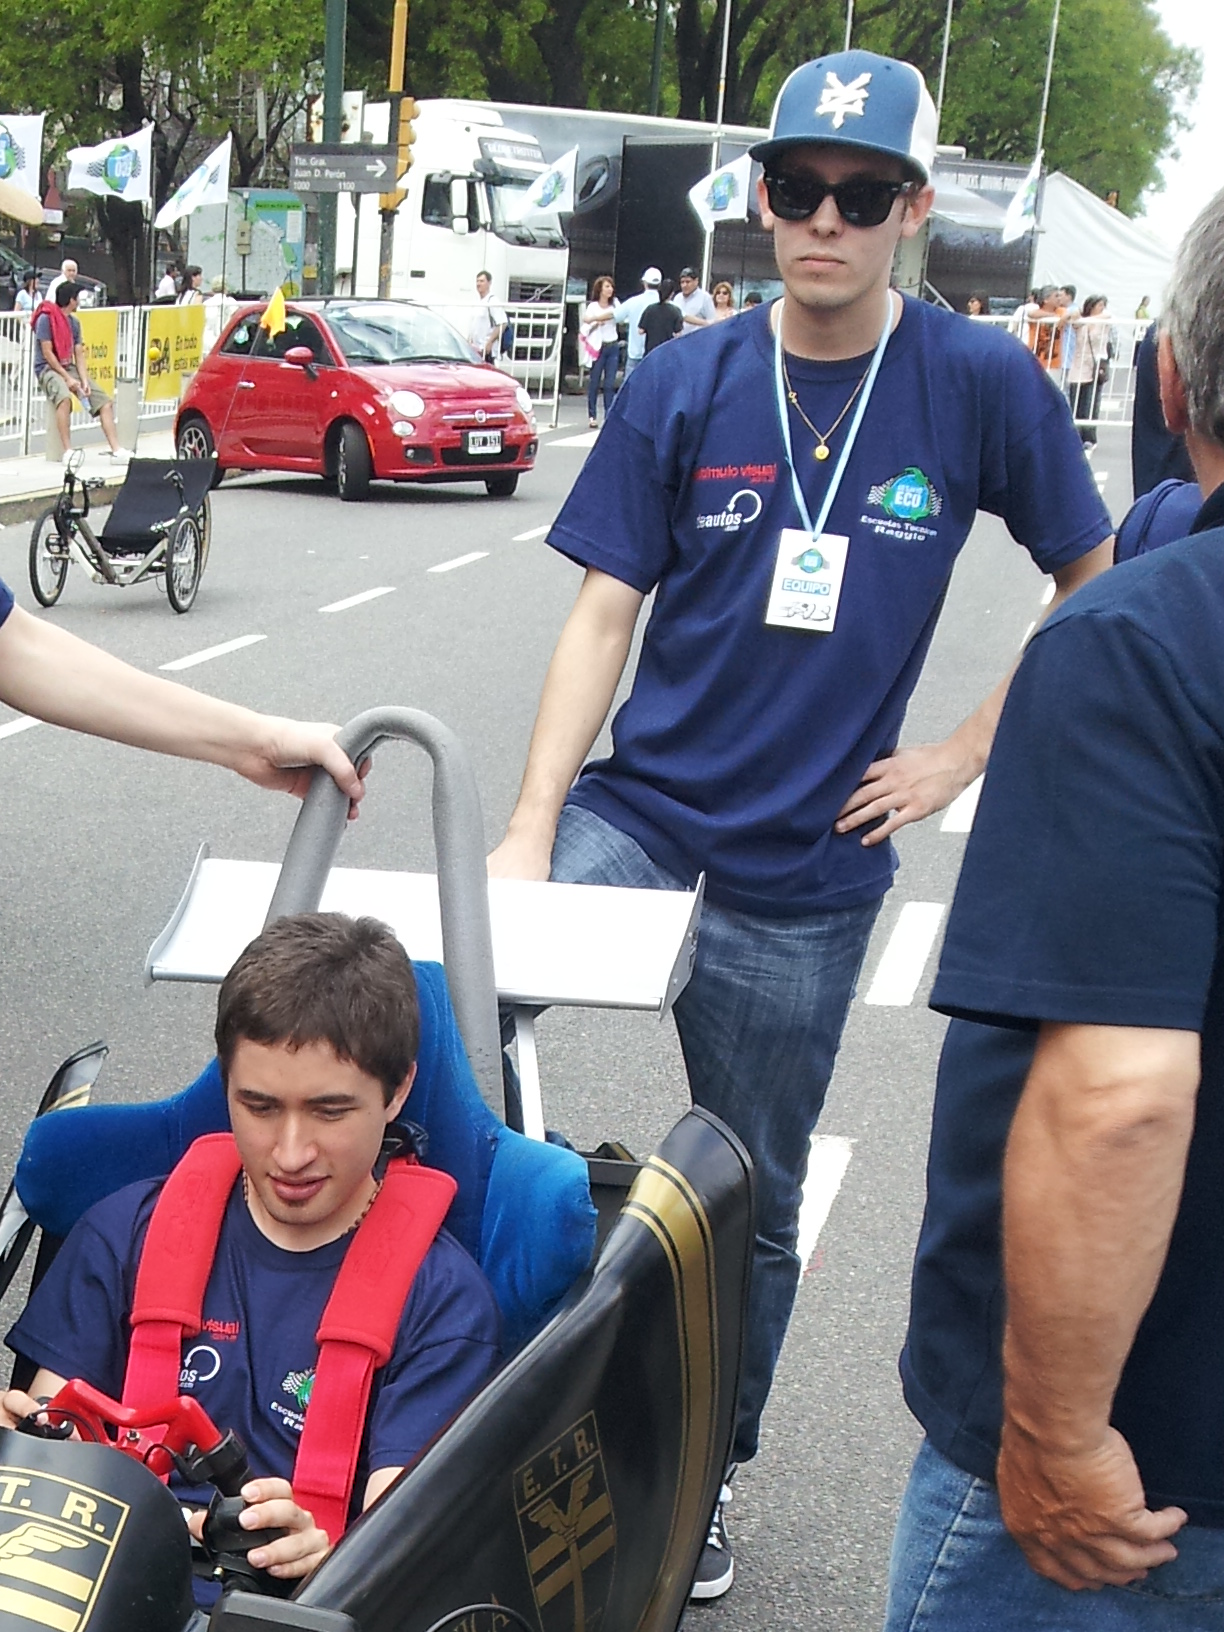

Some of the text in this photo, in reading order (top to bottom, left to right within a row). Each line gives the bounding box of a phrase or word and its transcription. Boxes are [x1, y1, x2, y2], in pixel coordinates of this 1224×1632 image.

[294, 169, 312, 177] Juan
[338, 181, 355, 190] 1100
[894, 491, 922, 508] ECO
[874, 524, 926, 541] Raggio
[782, 578, 831, 596] EQUIPO
